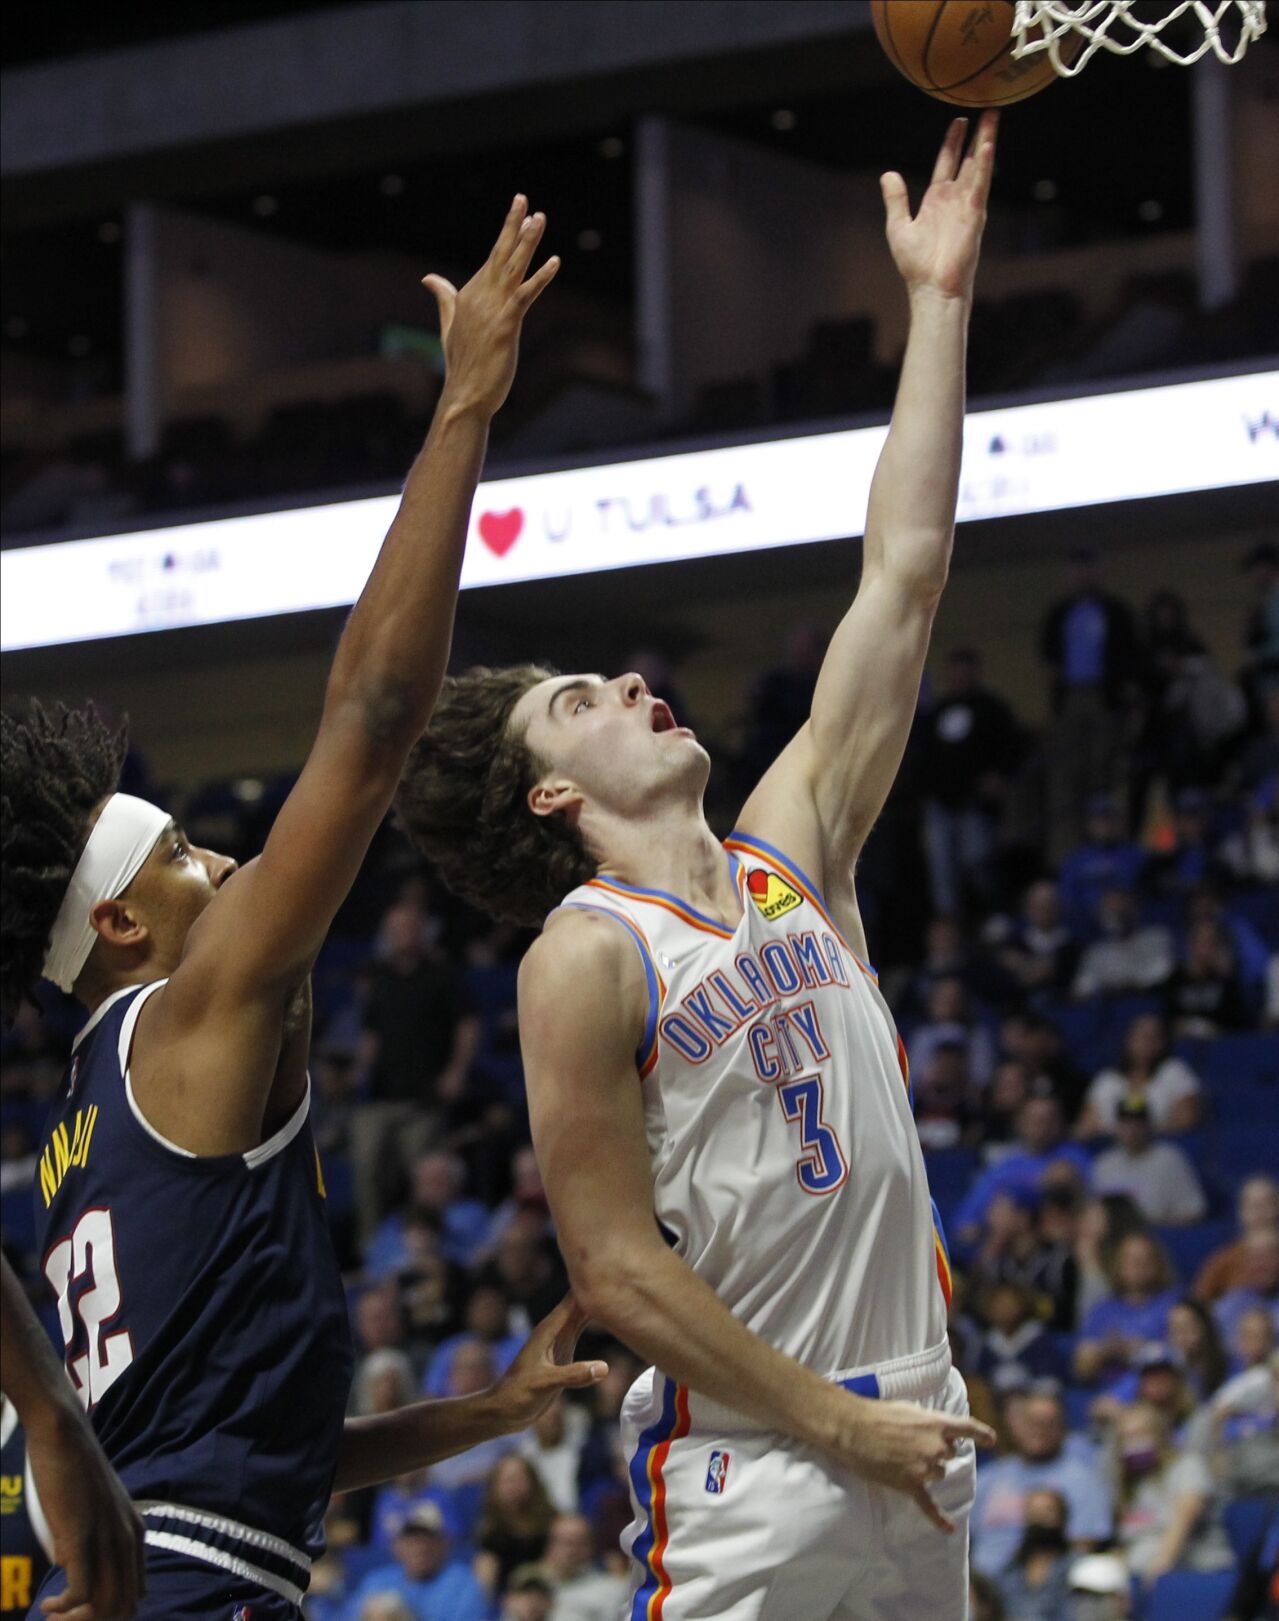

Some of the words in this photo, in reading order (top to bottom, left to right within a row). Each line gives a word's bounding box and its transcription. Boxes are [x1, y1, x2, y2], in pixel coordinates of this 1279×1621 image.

[542, 505, 574, 543] U
[594, 481, 754, 534] TULSA
[659, 931, 850, 1066] OKLAOMA
[747, 1000, 832, 1084] CITY
[776, 1073, 848, 1196] 3
